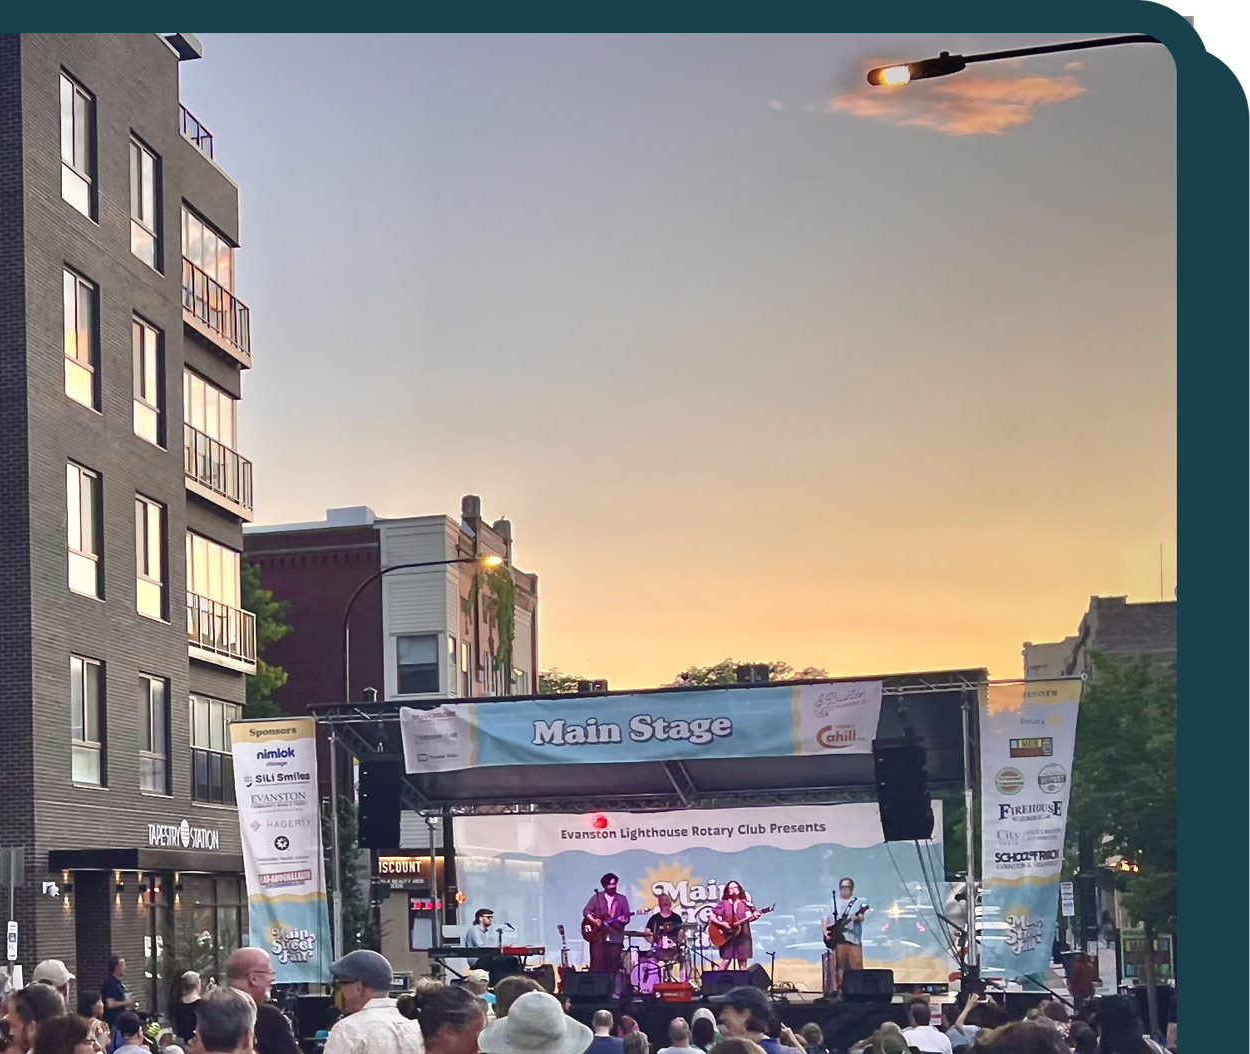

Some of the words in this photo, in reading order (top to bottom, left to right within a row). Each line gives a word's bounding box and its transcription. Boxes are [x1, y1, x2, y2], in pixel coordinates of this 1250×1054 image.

[249, 727, 297, 738] Sponsors
[532, 718, 623, 746] Main
[629, 713, 734, 745] Stage
[816, 725, 856, 749] Cahill
[257, 747, 296, 760] nimlok
[277, 772, 311, 782] Smiles
[251, 791, 306, 803] EVANSTON
[998, 801, 1063, 820] FIREHOUSE
[267, 820, 311, 829] HAGERTY
[148, 824, 180, 847] TAPESTRY
[191, 827, 219, 850] STATION
[561, 829, 617, 839] Evanston
[620, 827, 688, 841] Lighthouse
[692, 826, 734, 838] Rotary
[738, 823, 766, 835] Club
[770, 822, 827, 834] Presents
[379, 861, 422, 873] ISCOUNT
